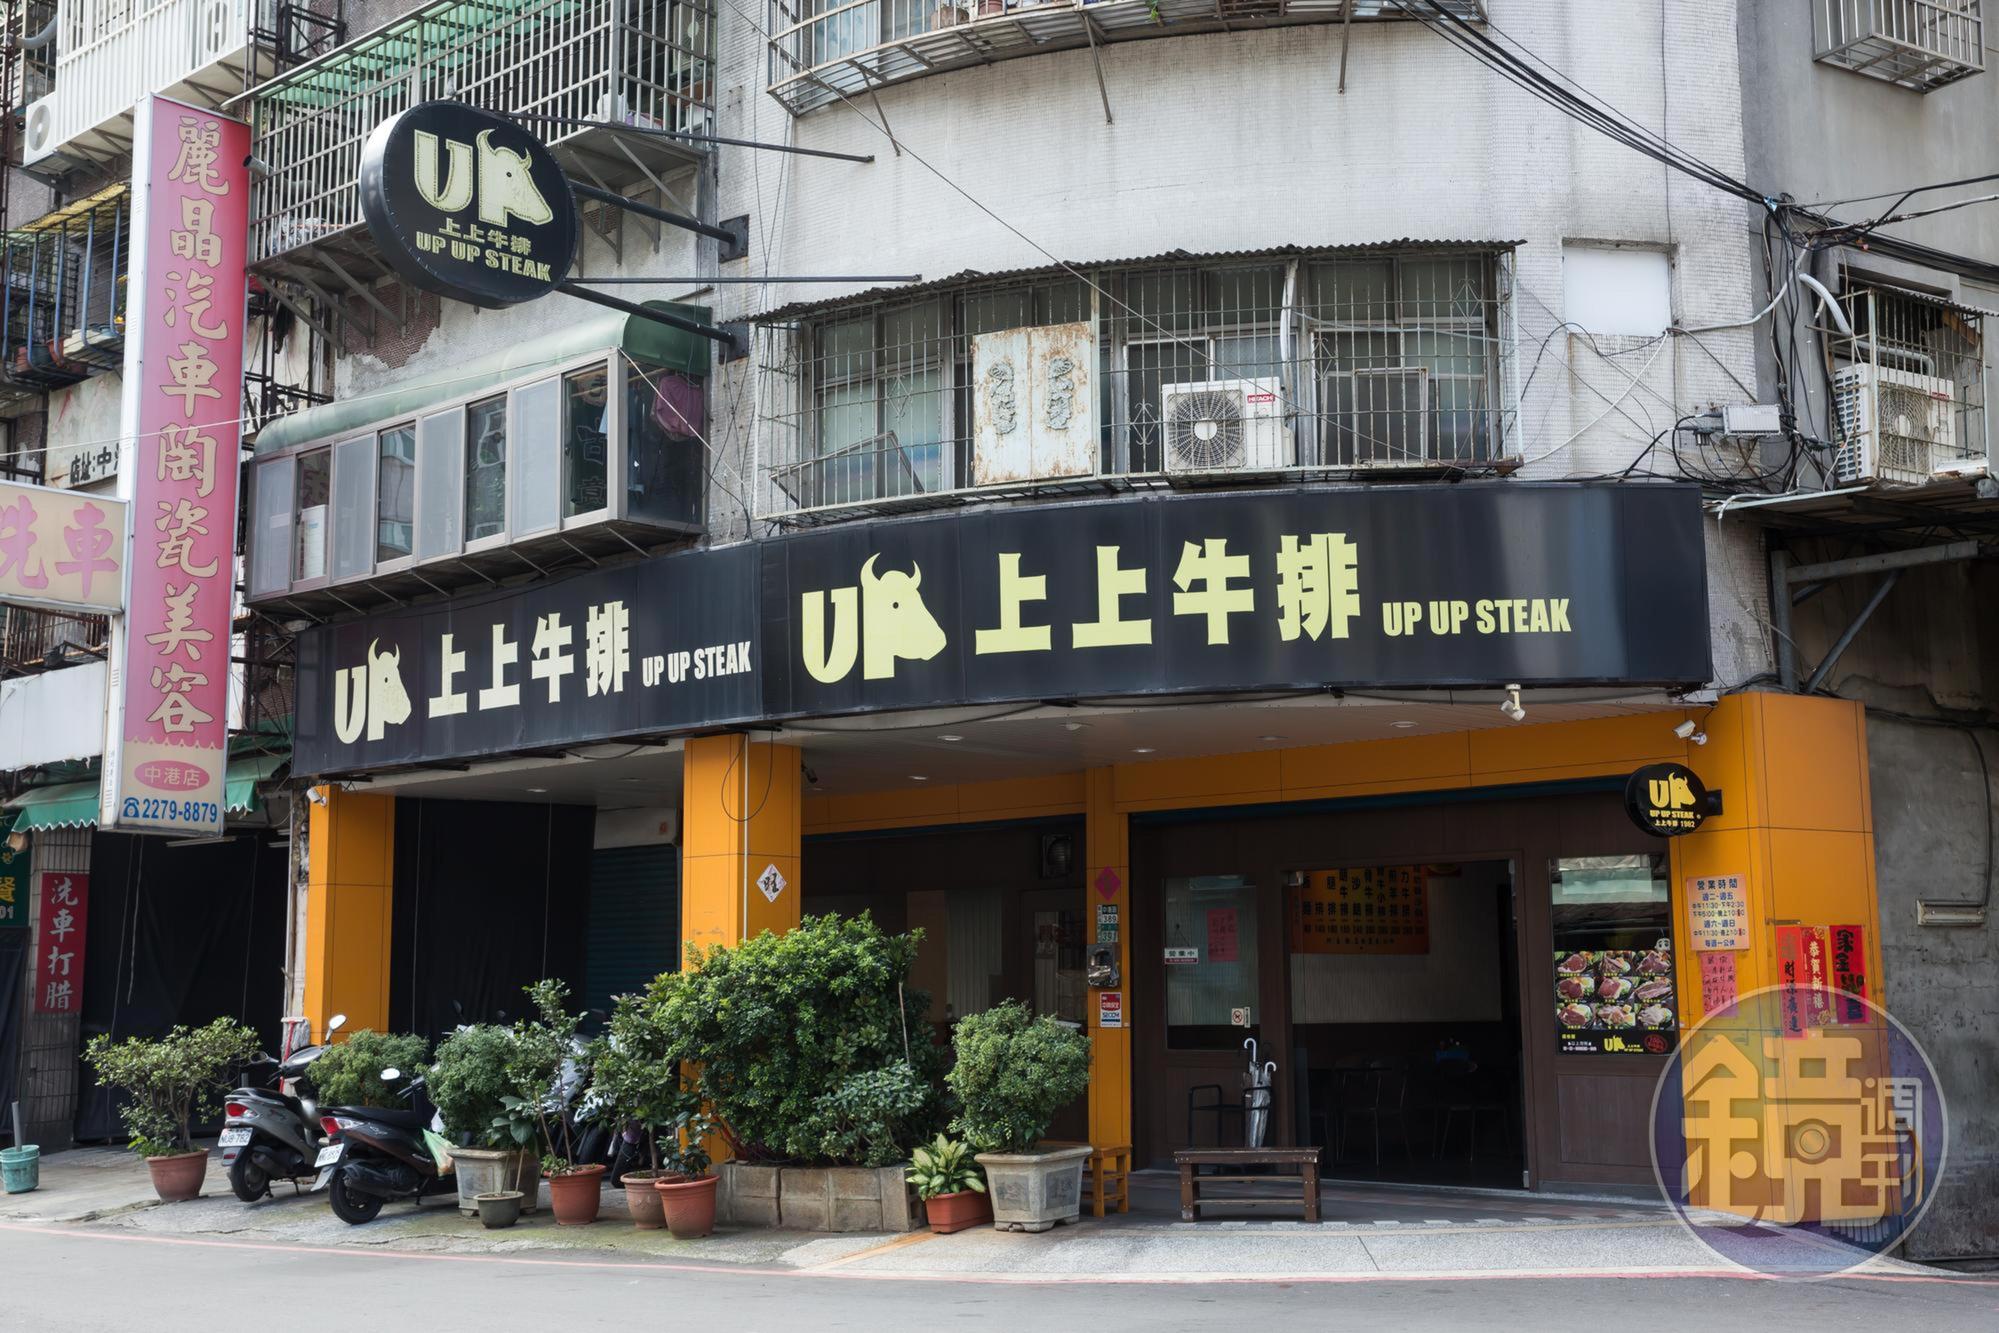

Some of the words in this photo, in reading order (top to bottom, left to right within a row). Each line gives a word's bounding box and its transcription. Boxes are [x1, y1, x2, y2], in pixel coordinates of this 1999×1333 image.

[416, 231, 446, 254] UP
[451, 240, 480, 263] UP
[485, 249, 551, 282] STEAK
[439, 218, 532, 256] 上上牛排
[145, 116, 230, 736] 麗晶汽車陶瓷美容
[975, 532, 1361, 655] 上上牛排
[1382, 602, 1422, 637] UP
[1429, 601, 1469, 635] UP
[1475, 598, 1572, 634] STEAK
[428, 601, 630, 719] 上上牛排
[642, 656, 664, 688] UP
[668, 651, 690, 684] UP
[694, 641, 752, 680] STEAK
[145, 766, 200, 787] 中港店
[142, 798, 218, 823] 2279-8879
[1650, 810, 1660, 818] UP
[1661, 810, 1671, 818] UP
[1672, 810, 1694, 819] STEAK
[1697, 878, 1737, 890] 營業時間
[1103, 915, 1117, 923] 389
[45, 876, 79, 1010] 洗車打腊
[1809, 941, 1824, 1009] 恭賀新禧
